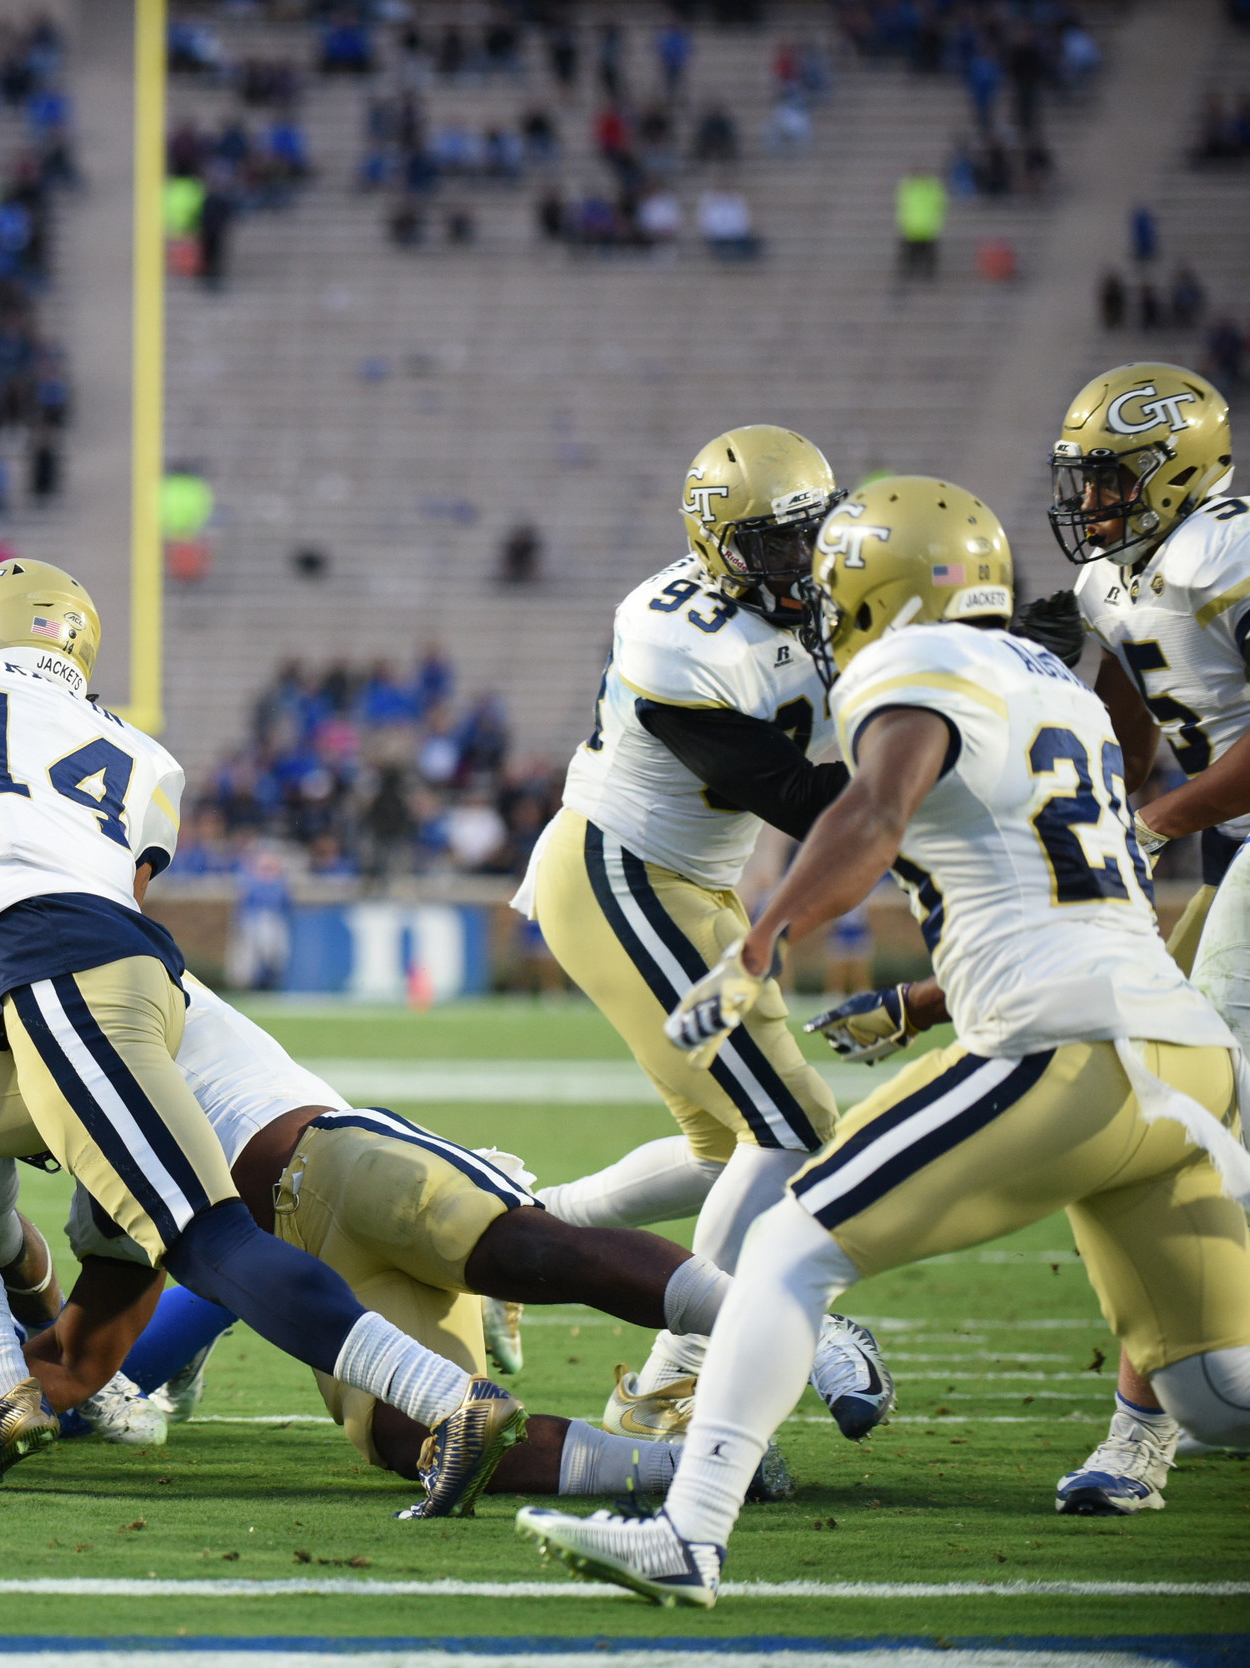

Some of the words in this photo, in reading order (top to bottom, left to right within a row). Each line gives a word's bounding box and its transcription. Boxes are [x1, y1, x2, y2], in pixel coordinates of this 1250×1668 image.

[1106, 385, 1196, 435] GT
[816, 503, 892, 569] GT
[723, 549, 749, 573] Ridde
[648, 579, 738, 635] 93
[965, 590, 1007, 610] JACKETS
[62, 640, 75, 655] 14
[36, 655, 84, 692] JACKETS
